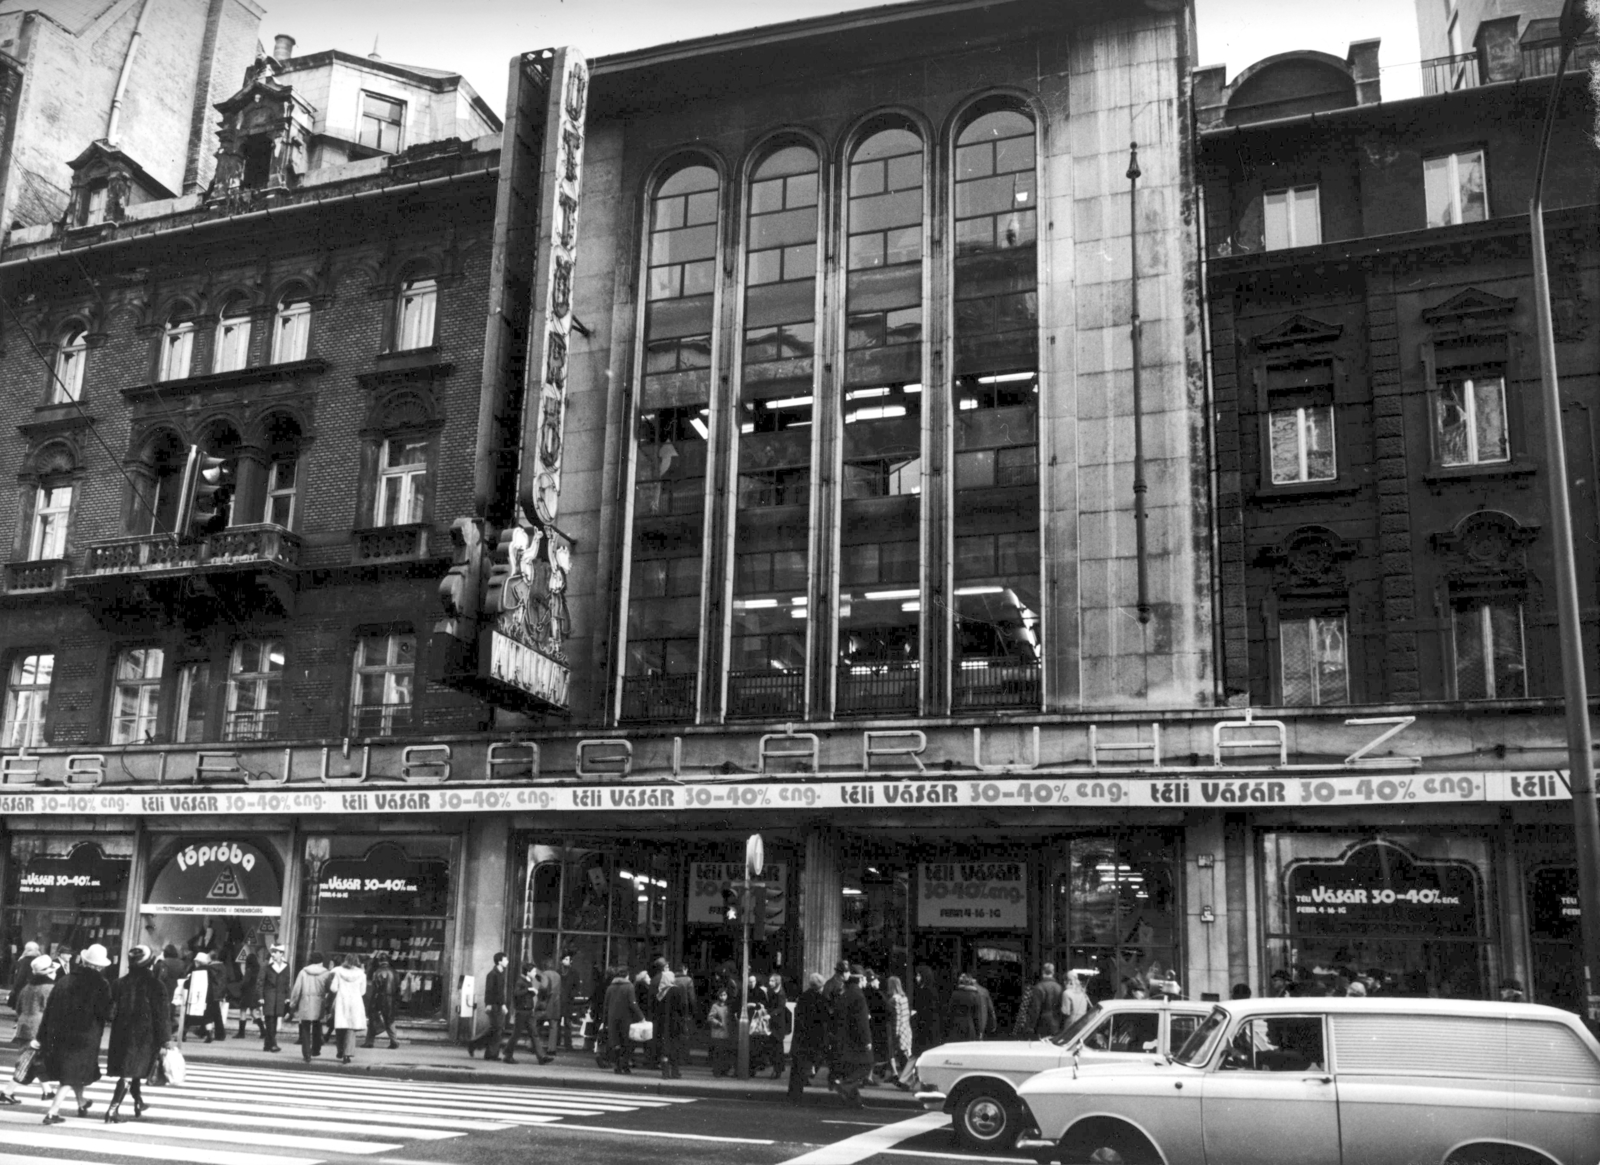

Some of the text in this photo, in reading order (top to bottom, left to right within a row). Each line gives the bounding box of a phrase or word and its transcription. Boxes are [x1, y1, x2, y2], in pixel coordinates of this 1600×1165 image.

[759, 707, 1422, 775] ÁRUHÁZ
[141, 795, 165, 811] téli
[341, 794, 368, 811] téli
[516, 790, 555, 809] eng.
[572, 789, 603, 807] téli
[778, 786, 822, 806] eng.
[840, 785, 875, 804] téli
[1076, 782, 1129, 802] eng.
[1151, 782, 1190, 803] téli
[1422, 777, 1482, 799] eng.
[1511, 775, 1556, 798] téli
[177, 841, 256, 872] főpróba
